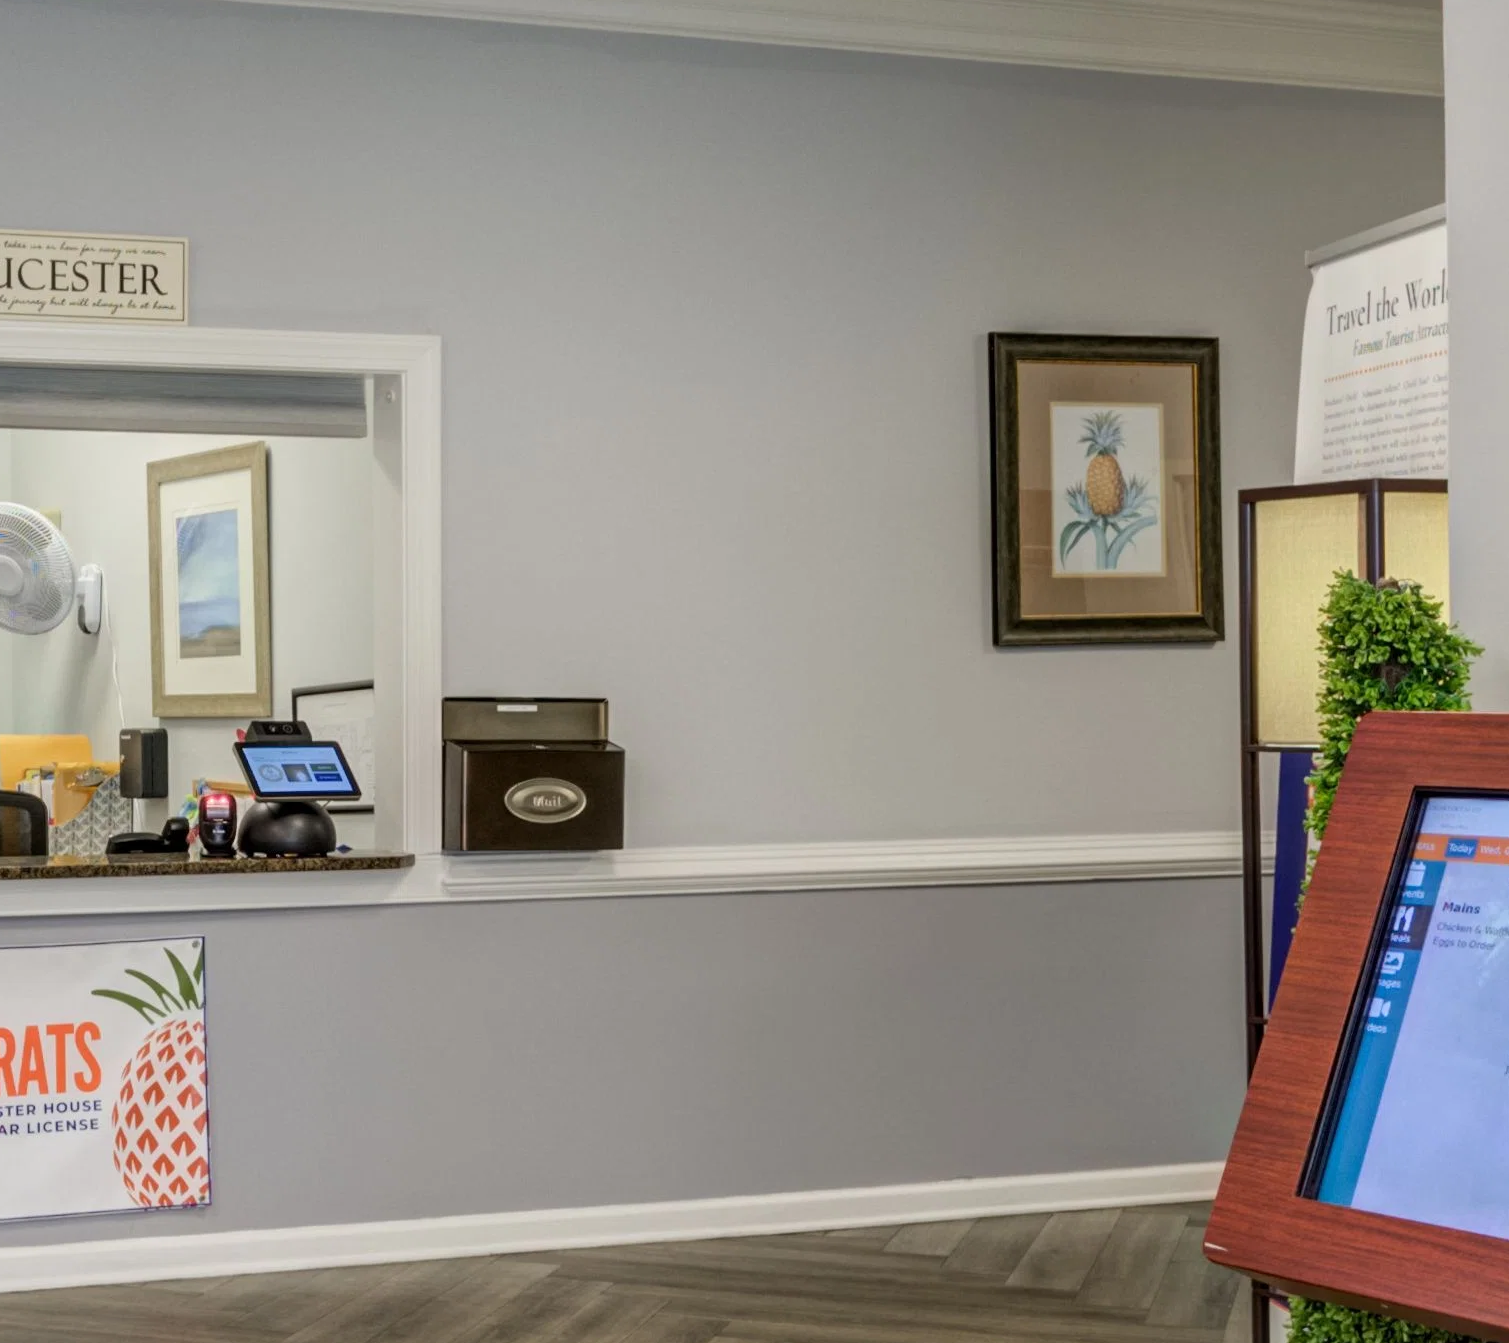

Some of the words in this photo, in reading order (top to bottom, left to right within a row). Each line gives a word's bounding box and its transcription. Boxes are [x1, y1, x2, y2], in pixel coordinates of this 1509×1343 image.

[80, 244, 95, 256] far
[8, 298, 46, 312] journey
[50, 297, 65, 306] but
[69, 297, 89, 307] will
[1327, 290, 1371, 335] Travel
[1376, 286, 1399, 322] the
[1405, 268, 1448, 311] Worl
[1448, 842, 1474, 856] Today
[1442, 901, 1481, 915] Mains
[1436, 921, 1473, 934] Chicken
[1432, 937, 1457, 950] Eggs
[1458, 939, 1467, 948] to
[1469, 939, 1495, 952] Order
[44, 1099, 103, 1114] HOUSE
[26, 1118, 99, 1135] LICENSE
